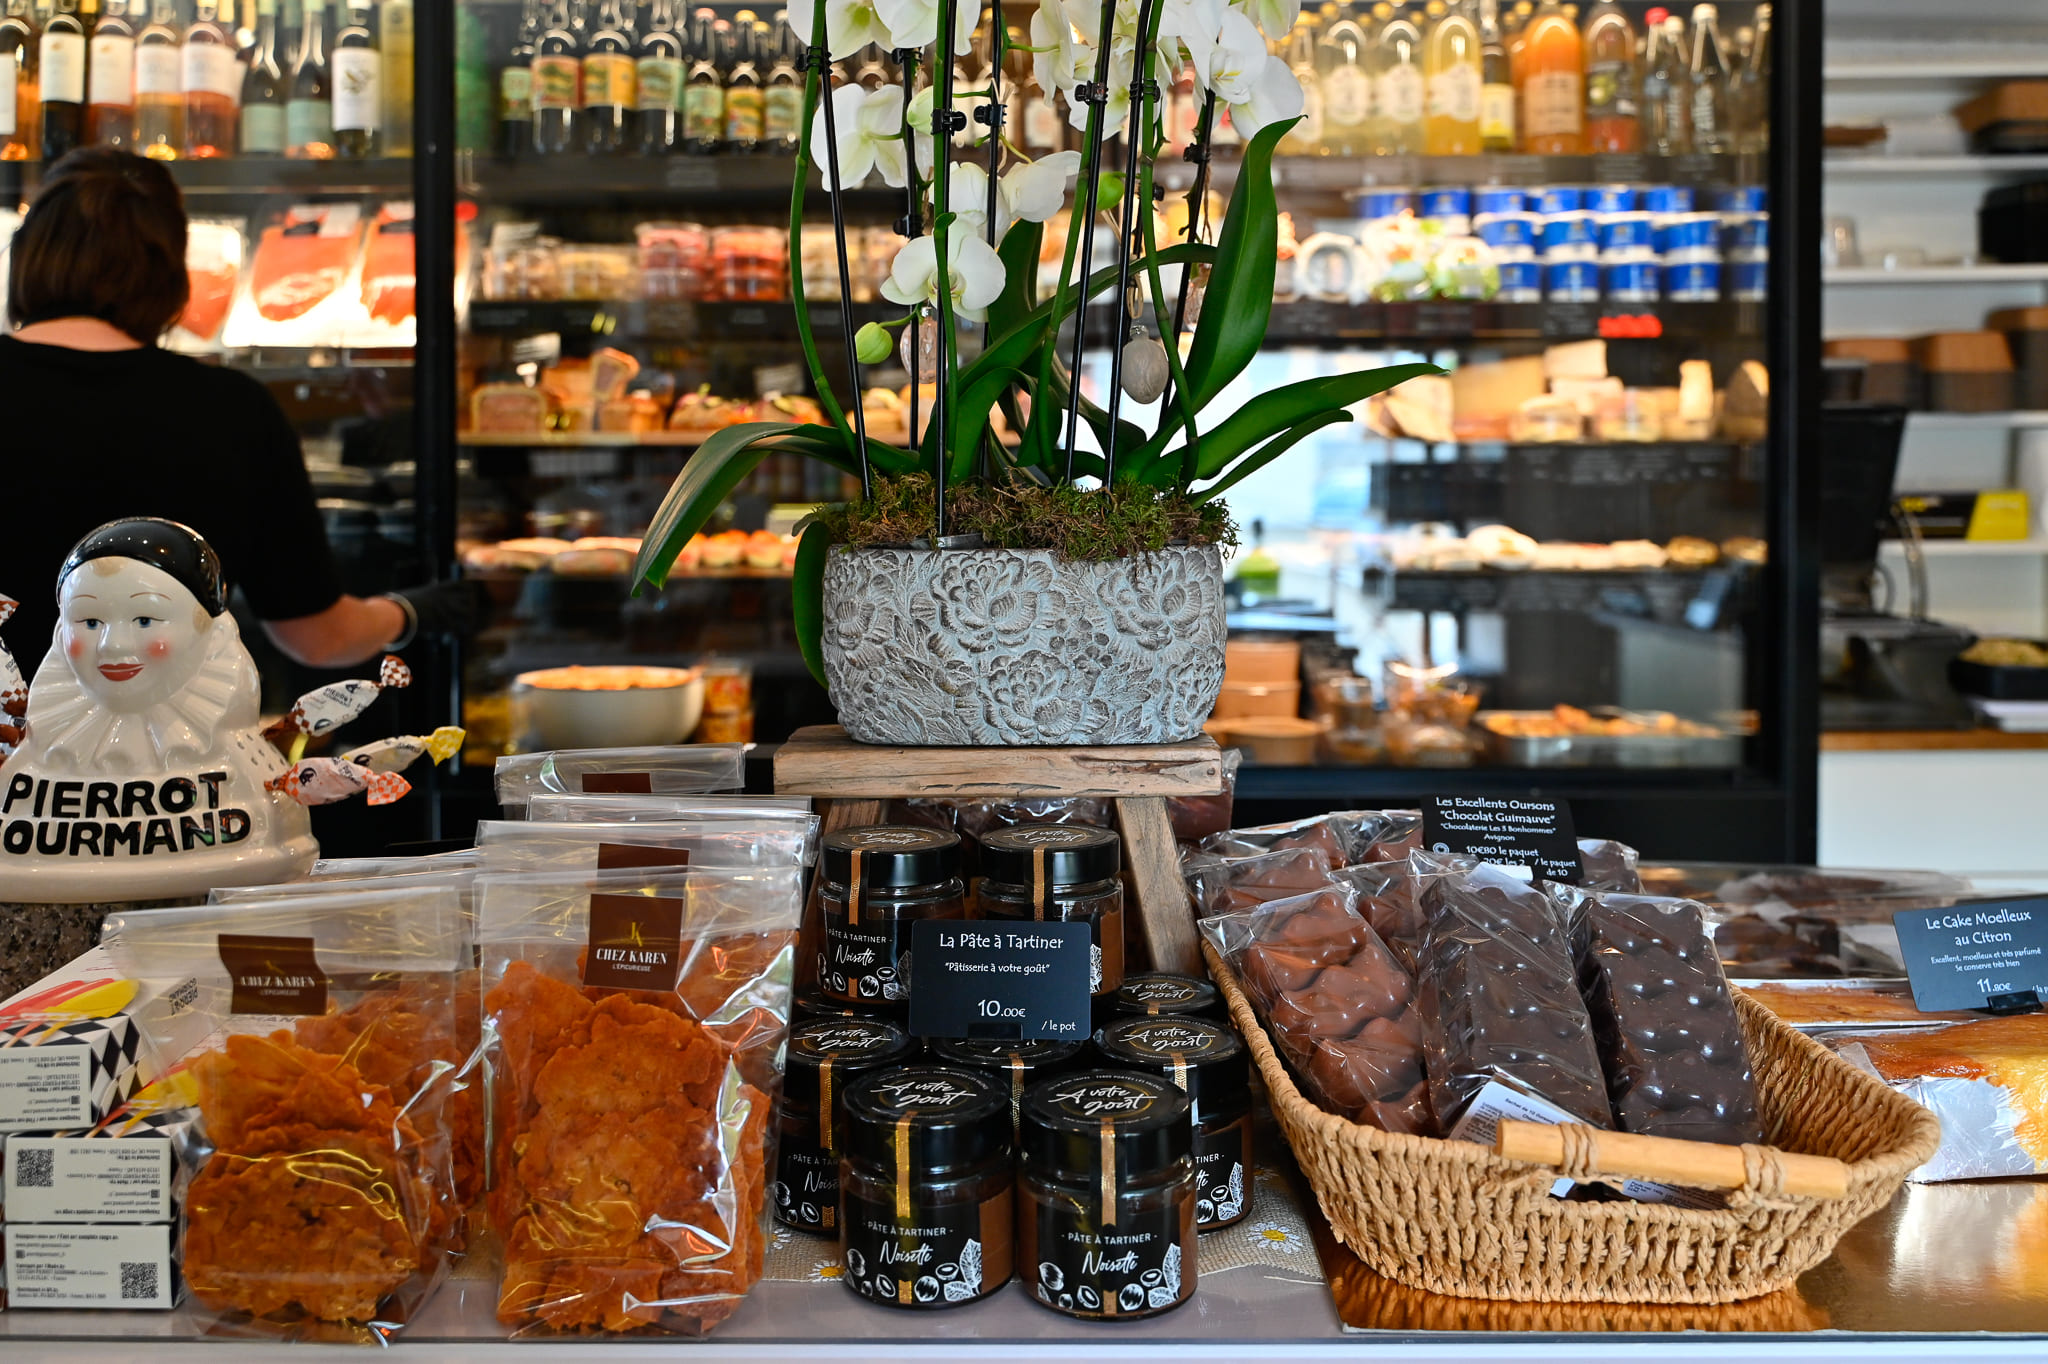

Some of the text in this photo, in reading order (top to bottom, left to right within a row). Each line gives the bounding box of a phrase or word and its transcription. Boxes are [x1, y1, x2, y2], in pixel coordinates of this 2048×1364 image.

[3, 772, 227, 820] PIERROT
[1436, 797, 1555, 811] Les Excellents Oursons
[1440, 810, 1555, 824] "Chocolat Guimauve"
[0, 809, 251, 857] OURMAND
[1484, 834, 1515, 842] Avignon
[1466, 845, 1539, 858] 10€80 le paquet
[1541, 858, 1548, 866] le
[1550, 860, 1576, 869] paquet
[1547, 868, 1556, 876] de
[1925, 909, 2032, 930] Le Cake Moelleux
[843, 932, 848, 940] À
[850, 933, 887, 944] TARTINER
[939, 932, 1064, 950] La Pâte à Tartiner
[1955, 932, 2012, 947] au Citron
[596, 948, 667, 964] CHEZ KAREN
[835, 944, 875, 966] Noisette
[1931, 954, 1961, 965] Excellent,
[1963, 952, 1992, 961] moelleux
[2015, 947, 2041, 958] parfumé
[945, 961, 1051, 976] "Pâtisserie à votre goût"
[1955, 960, 2020, 972] Se conserve très bien
[275, 976, 315, 987] KAREN
[1976, 978, 2012, 993] 11.80€
[977, 999, 1026, 1019] 10.00€
[1050, 1020, 1058, 1030] le
[1060, 1021, 1076, 1033] pot
[1154, 1026, 1189, 1038] votre
[916, 1081, 956, 1092] votre
[1089, 1085, 1132, 1098] votre
[793, 1154, 811, 1165] PÂTE
[867, 1222, 947, 1238] PÂTE À TARTINER
[1068, 1231, 1152, 1246] PÂTE À TARTINER
[879, 1241, 934, 1265] Noisette
[1082, 1250, 1138, 1276] Noisette
